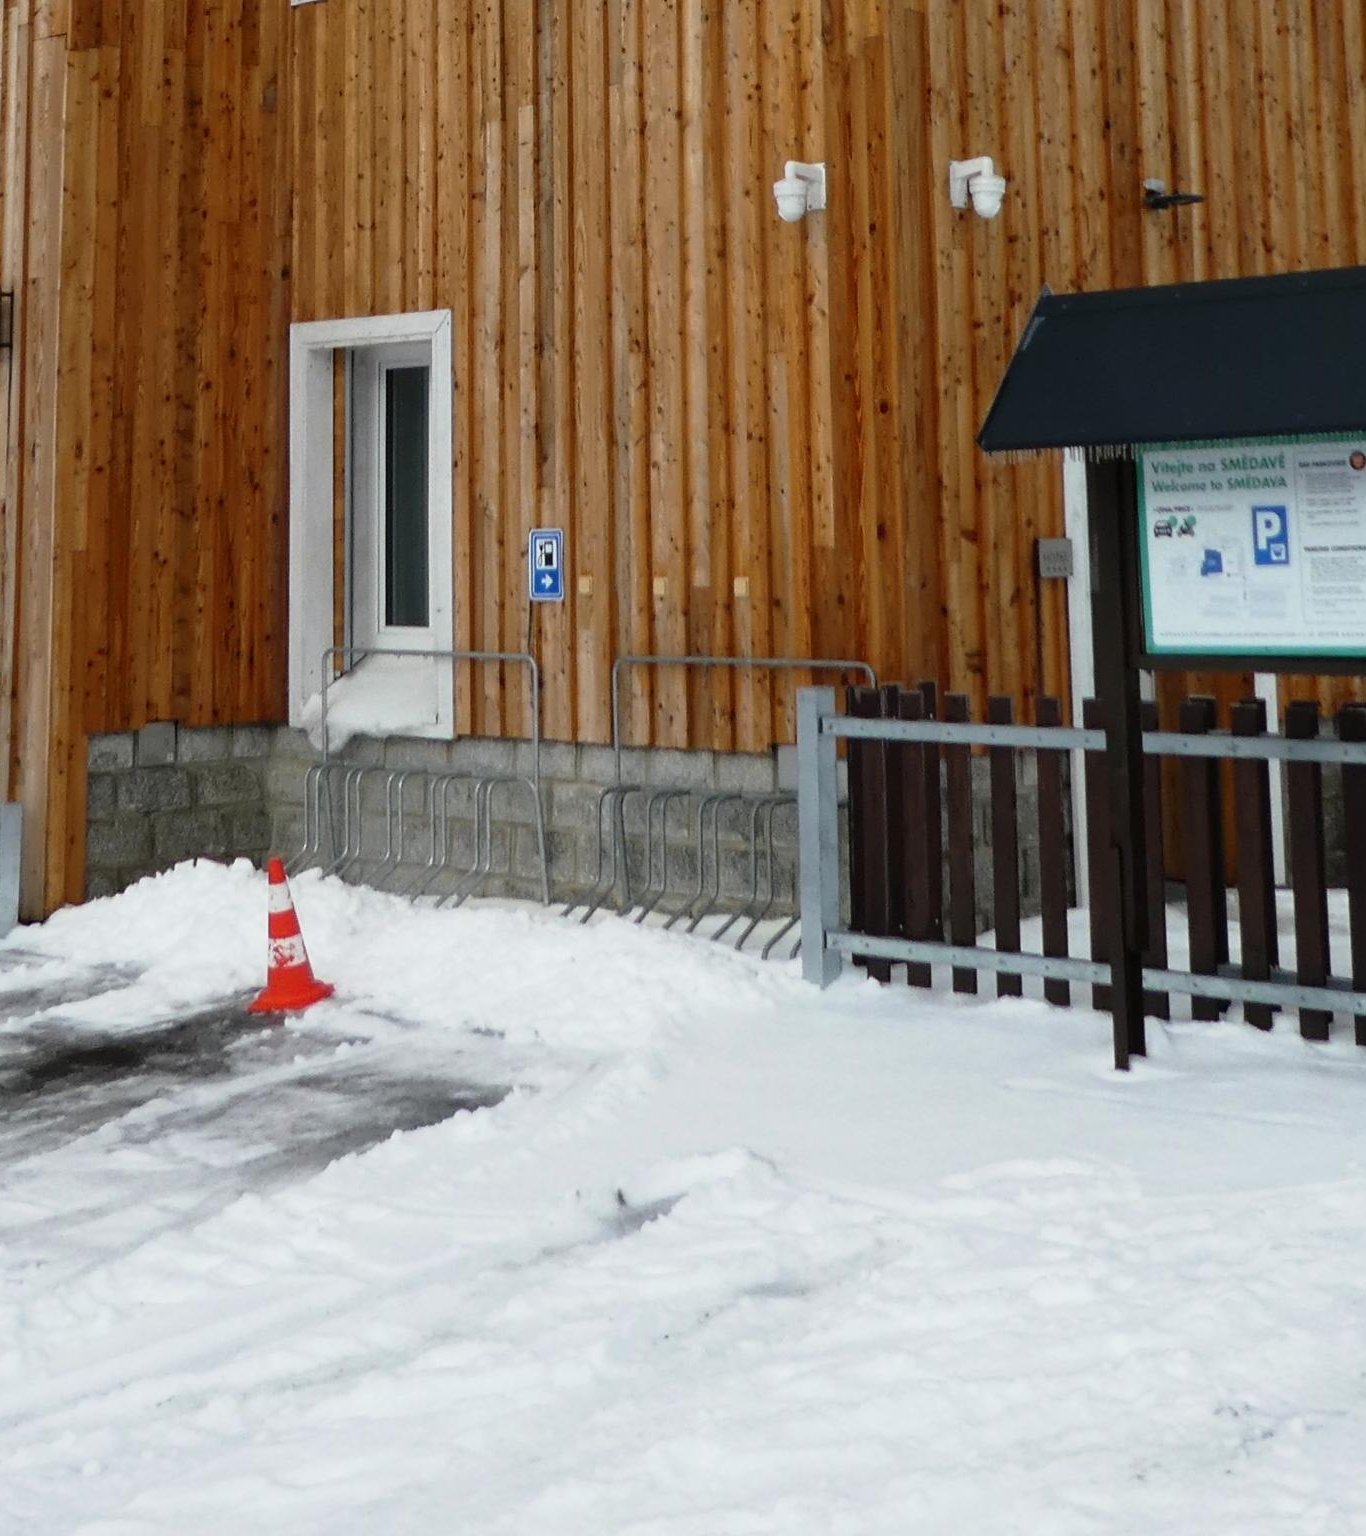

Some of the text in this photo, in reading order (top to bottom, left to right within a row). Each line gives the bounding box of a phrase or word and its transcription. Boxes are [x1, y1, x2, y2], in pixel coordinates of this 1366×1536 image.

[1198, 462, 1215, 472] na
[1151, 479, 1207, 492] Welcome
[1210, 480, 1223, 490] to
[1256, 511, 1281, 549] P
